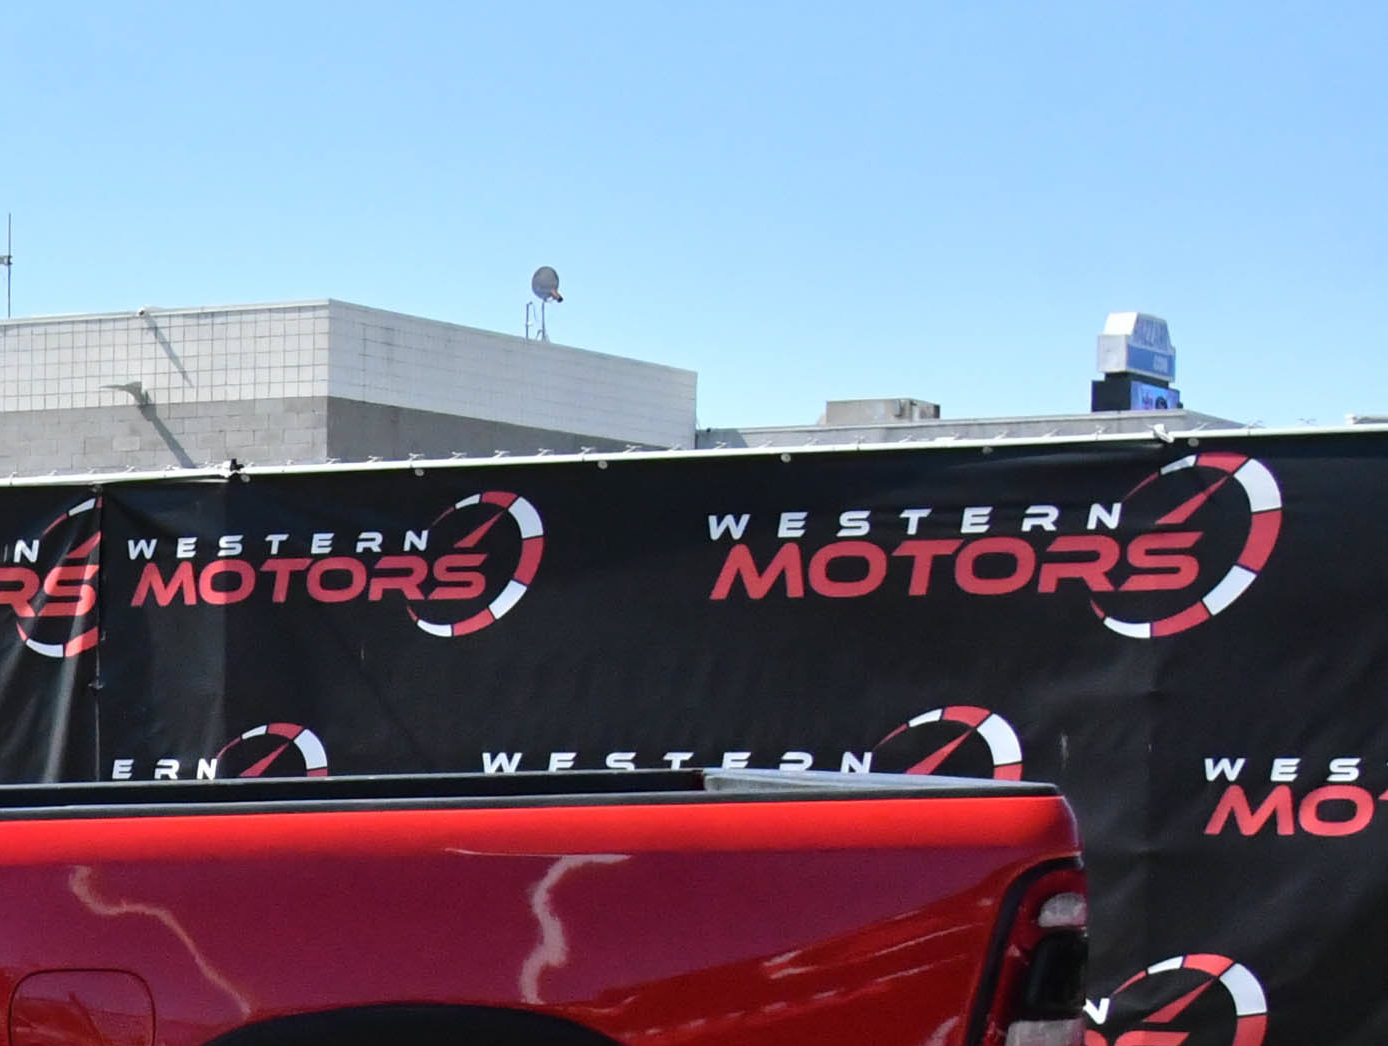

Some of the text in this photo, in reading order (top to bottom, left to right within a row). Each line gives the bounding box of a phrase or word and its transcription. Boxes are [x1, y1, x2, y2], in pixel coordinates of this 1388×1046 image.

[708, 502, 1122, 540] WESTERN
[128, 530, 429, 561] WESTERN
[710, 532, 1203, 600] MOTORS
[131, 554, 488, 608] MOTORS
[1204, 758, 1388, 782] WES
[1204, 785, 1388, 837] MO
